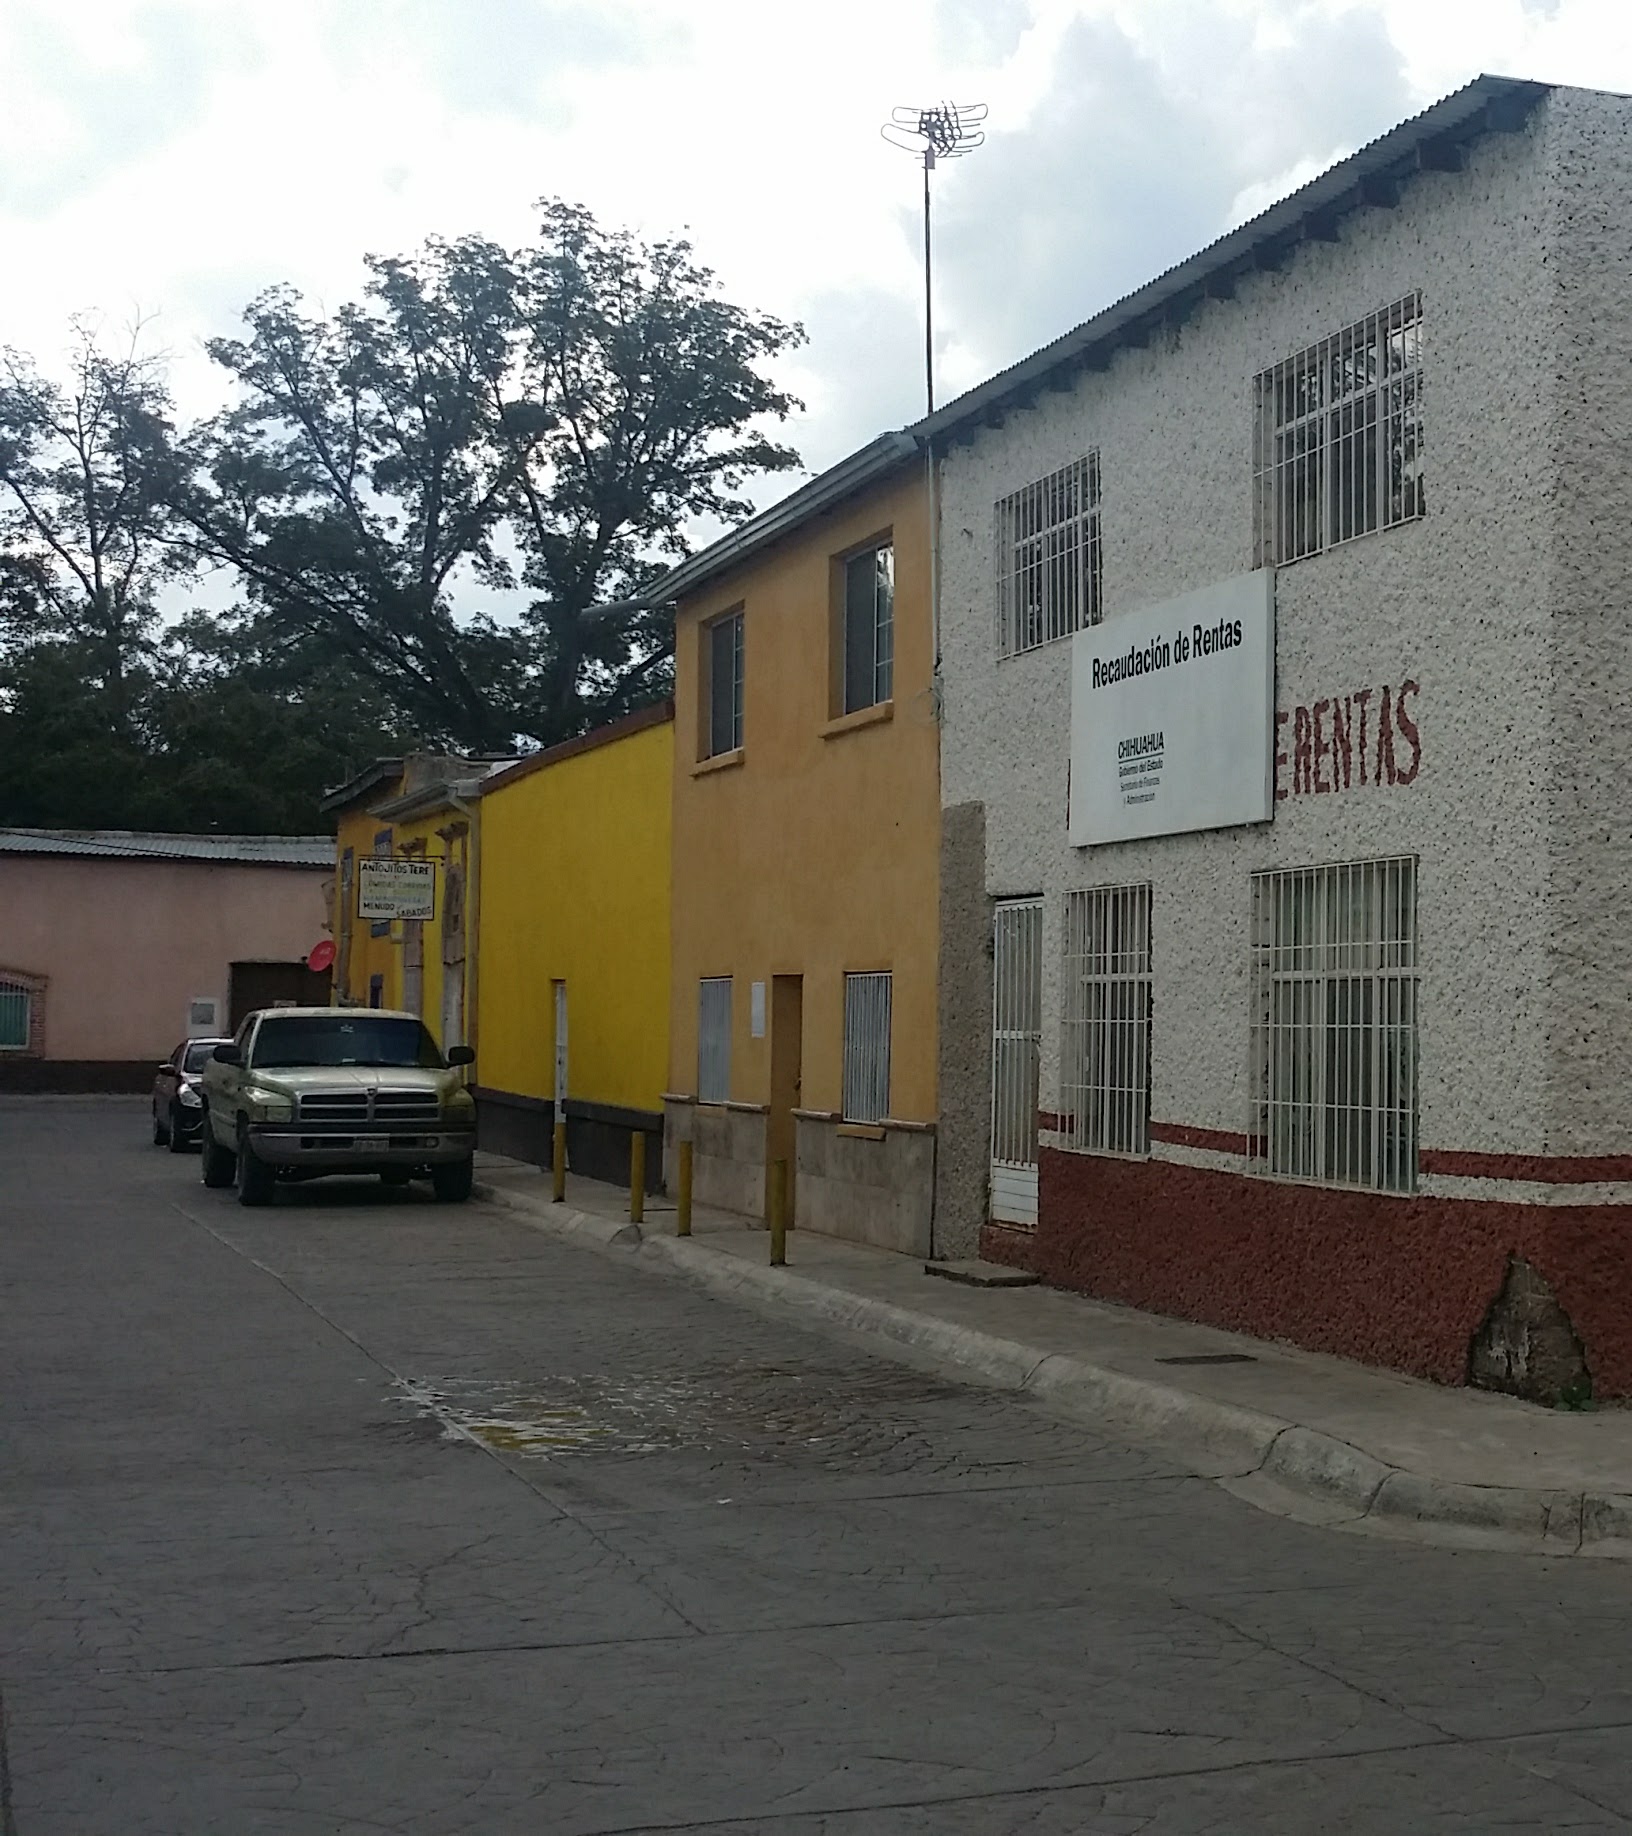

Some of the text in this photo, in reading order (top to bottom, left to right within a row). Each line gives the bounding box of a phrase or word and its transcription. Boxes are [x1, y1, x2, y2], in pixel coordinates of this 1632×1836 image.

[1092, 618, 1242, 689] Recaudación de Rentas
[1118, 731, 1164, 759] CHIHUAHUA
[362, 862, 407, 873] ANTOJITOS
